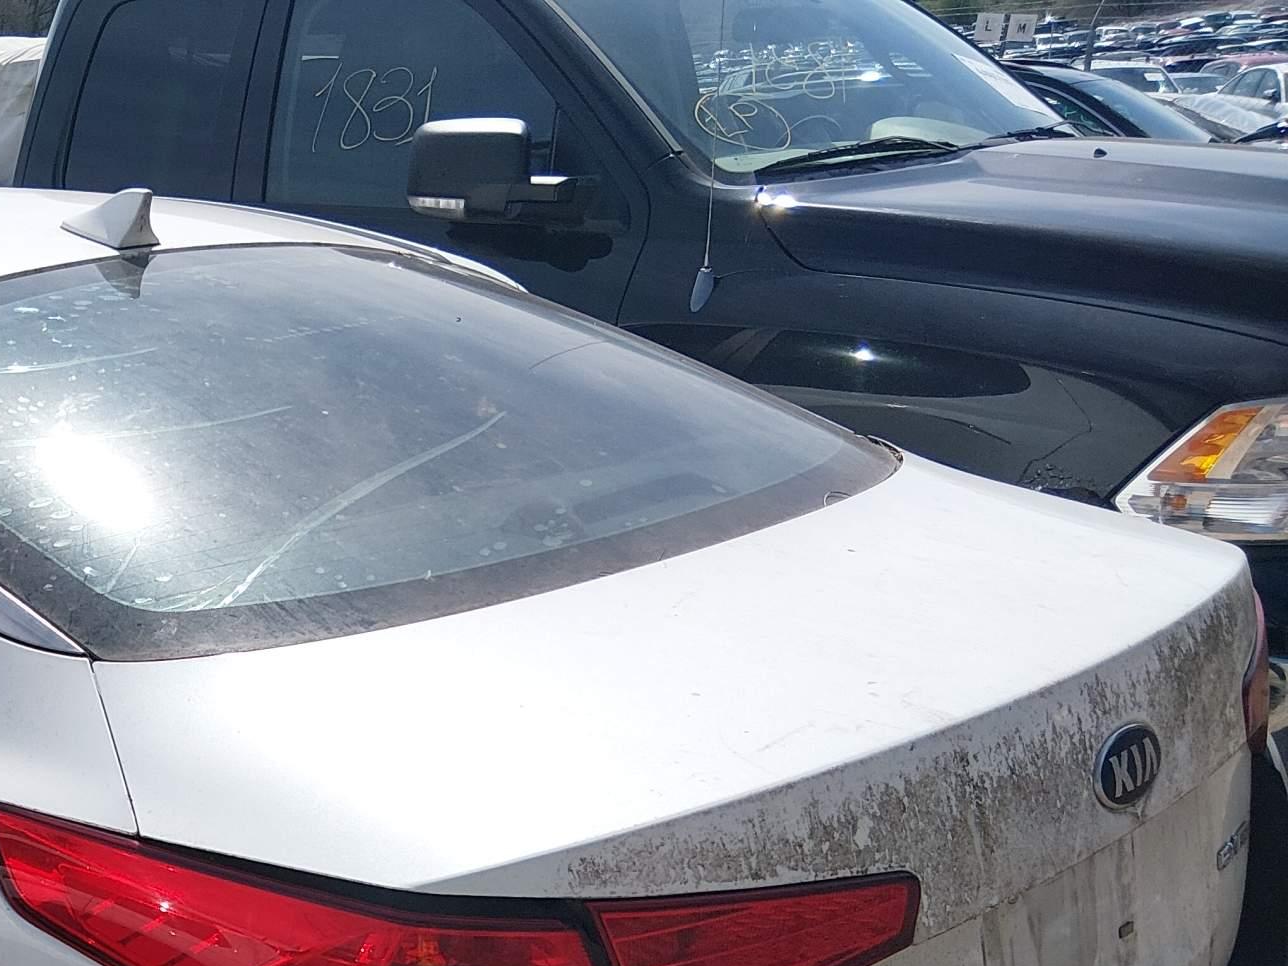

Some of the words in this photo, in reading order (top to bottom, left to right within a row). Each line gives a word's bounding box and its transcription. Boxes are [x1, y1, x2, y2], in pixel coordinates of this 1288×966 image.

[985, 21, 992, 31] L
[1017, 24, 1026, 33] M
[1109, 737, 1158, 798] KIA
